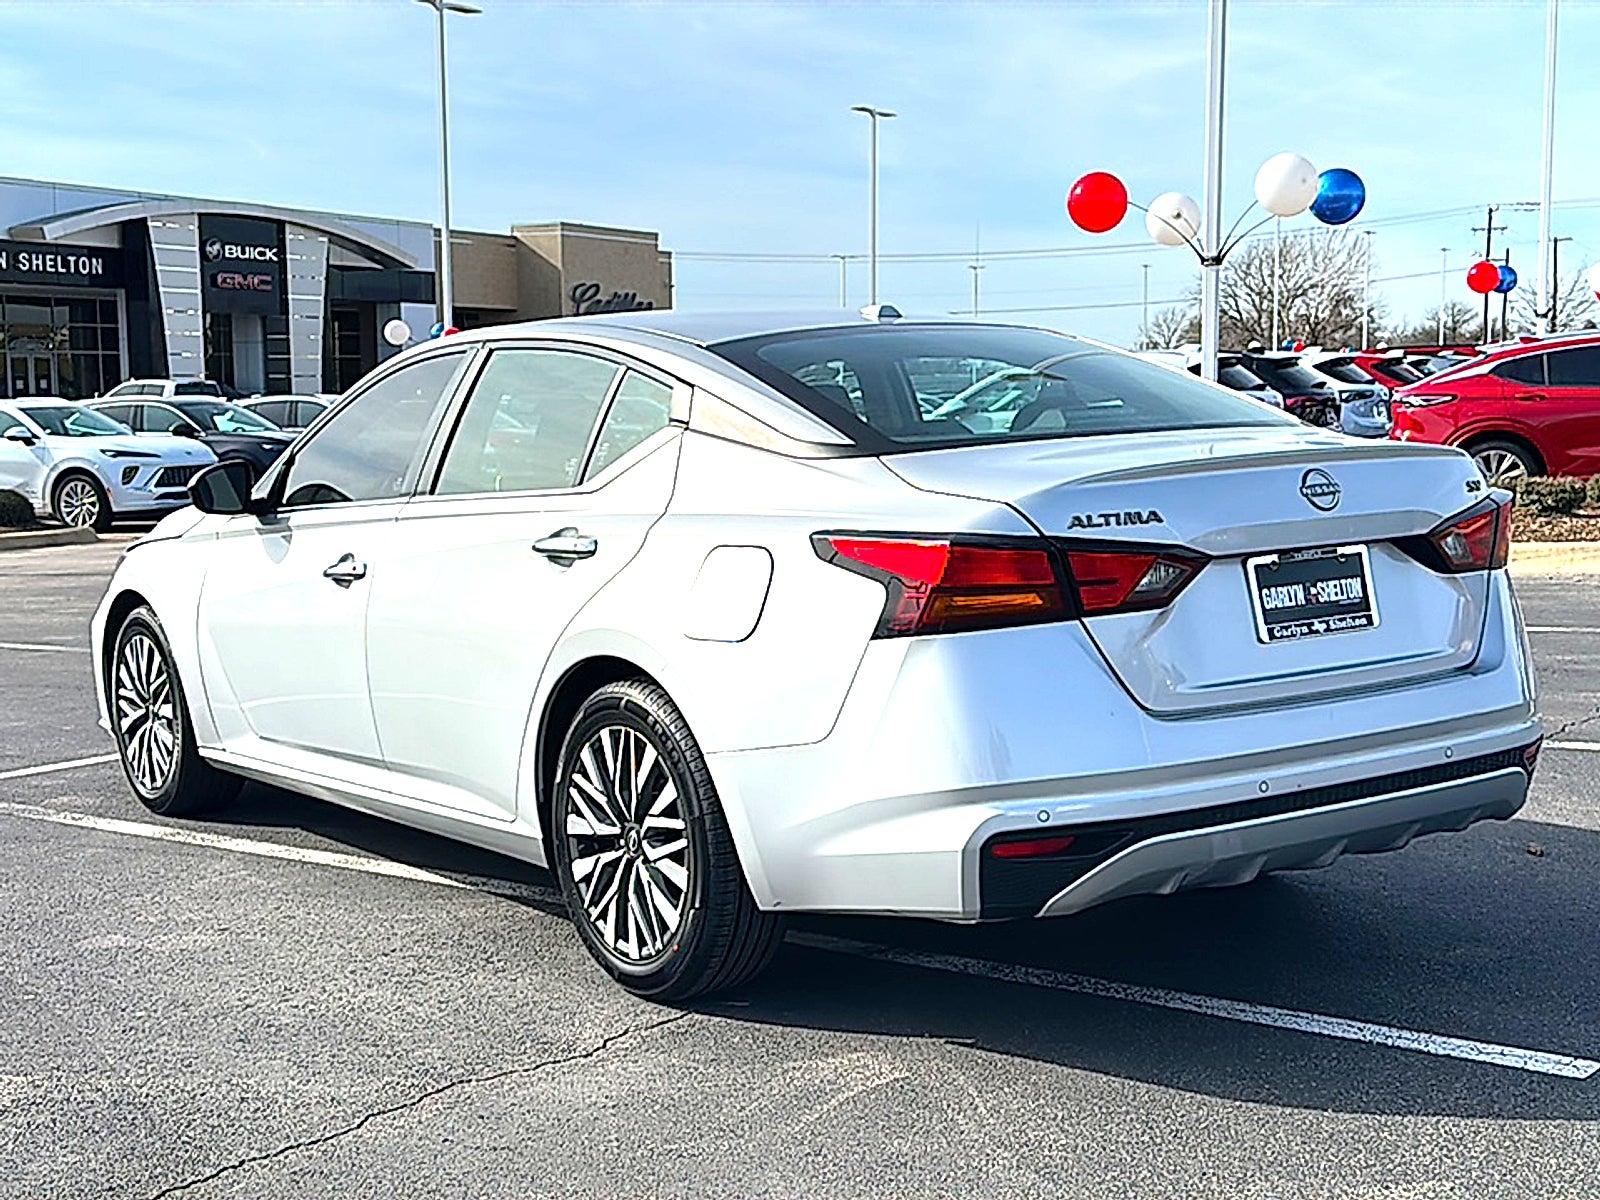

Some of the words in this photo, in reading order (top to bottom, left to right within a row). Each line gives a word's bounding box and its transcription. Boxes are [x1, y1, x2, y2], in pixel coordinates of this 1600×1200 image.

[224, 244, 279, 262] BUICK
[18, 252, 103, 275] SHELTON
[217, 272, 273, 292] GMC
[1067, 510, 1165, 530] ALTIMA
[1261, 583, 1306, 610] GARLYN
[1316, 576, 1363, 603] SHELTON
